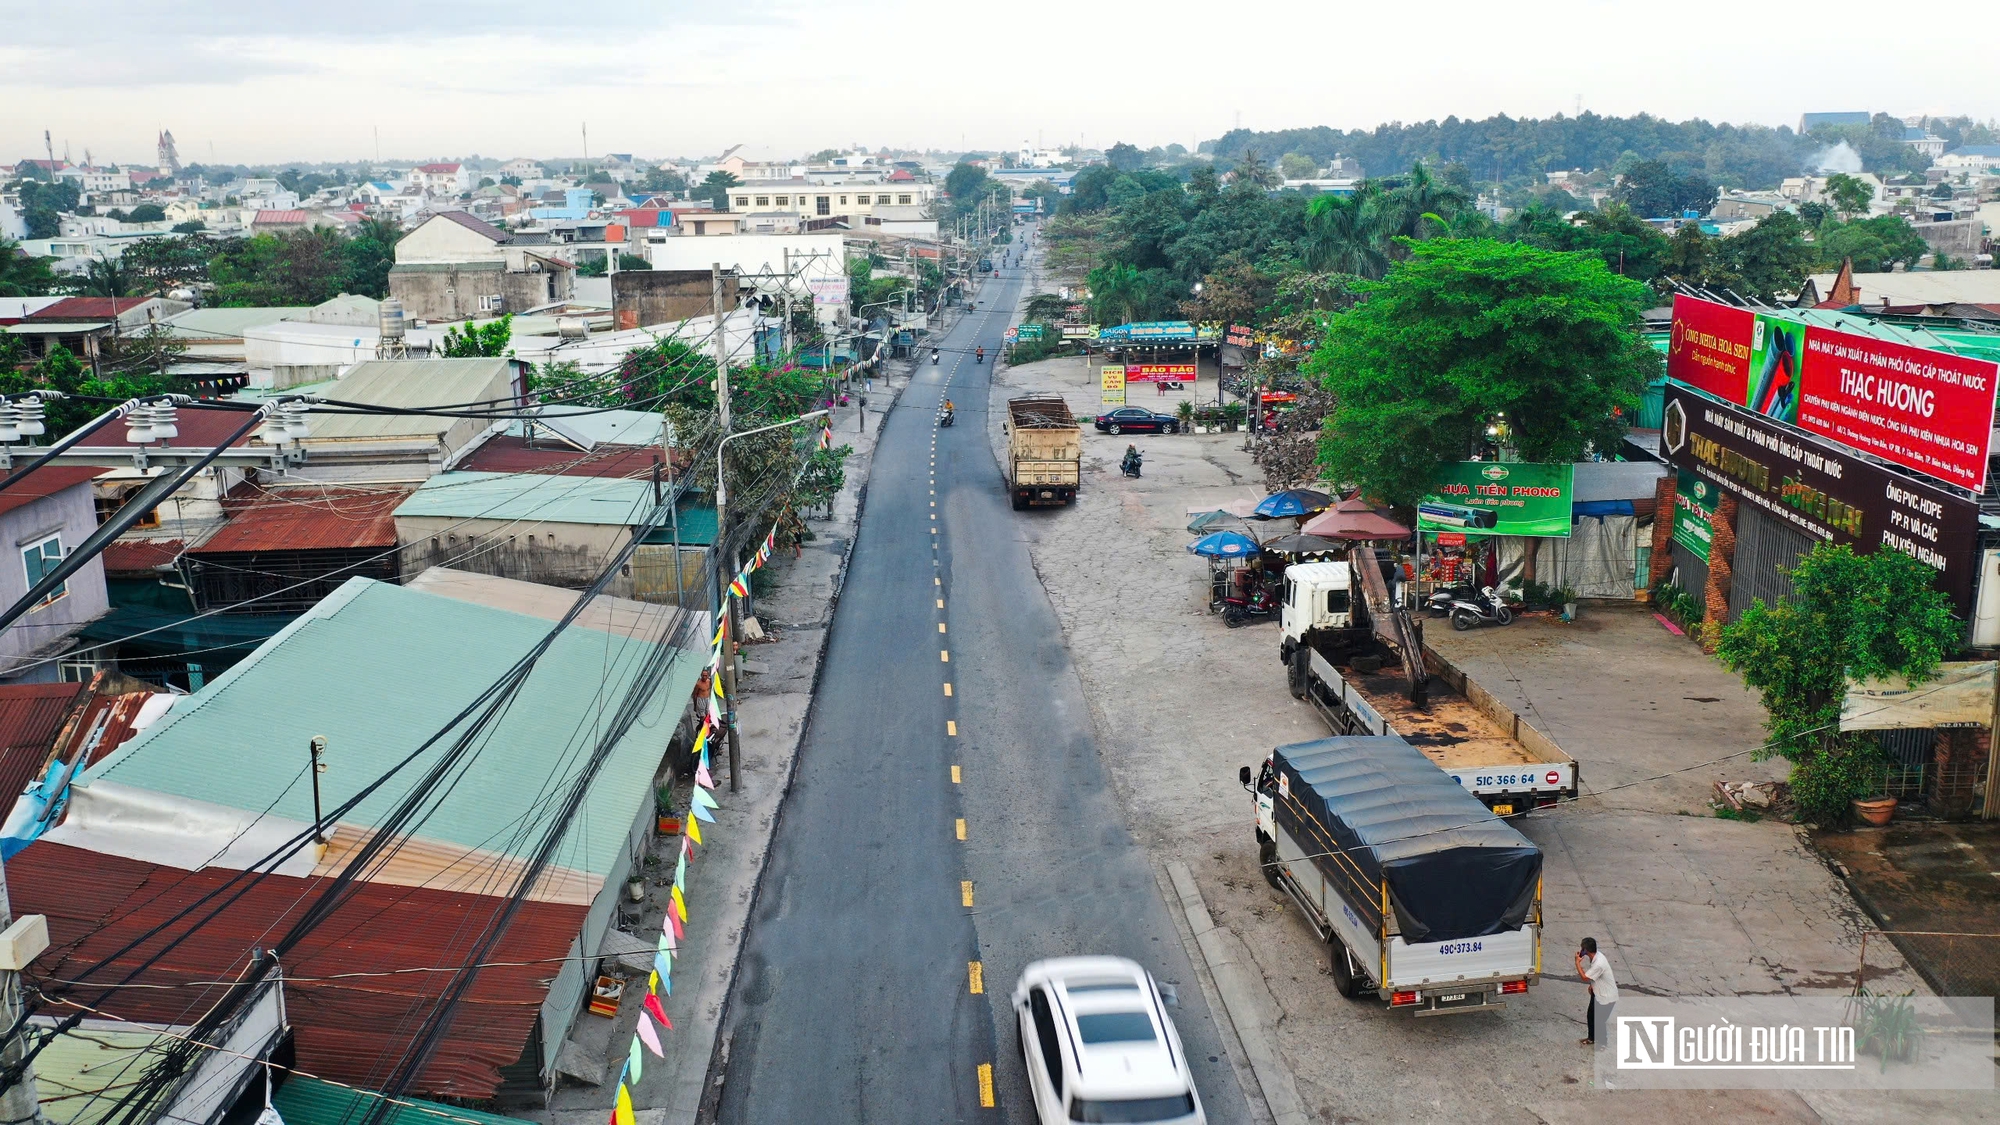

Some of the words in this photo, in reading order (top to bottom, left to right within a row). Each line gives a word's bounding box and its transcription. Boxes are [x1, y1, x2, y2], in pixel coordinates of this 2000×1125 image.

[1686, 323, 1698, 344] ỐNG
[1718, 338, 1732, 355] HOA
[1734, 344, 1750, 360] SEN
[1808, 338, 1820, 352] NHÀ
[1821, 341, 1834, 354] MÁY
[1864, 352, 1868, 363] &
[1869, 353, 1887, 368] PHÂN
[1888, 356, 1904, 372] PHỐI
[1905, 358, 1921, 376] ỐNG
[1922, 362, 1936, 379] CẤP
[1938, 369, 1962, 385] THOÁT
[1962, 374, 1986, 391] NƯỚC
[1840, 368, 1875, 404] THẠC
[1876, 378, 1935, 418] HƯƠNG
[1746, 428, 1751, 440] &
[1780, 435, 1791, 458] ỐNG
[1791, 442, 1803, 462] CẤP
[1804, 452, 1824, 471] THOÁT
[1824, 458, 1842, 479] NƯỚC
[1900, 422, 1907, 434] VÀ
[1951, 439, 1964, 452] HOA
[1966, 444, 1978, 456] SEN
[1440, 482, 1470, 497] HỰA
[1512, 486, 1560, 497] PHONG
[1886, 480, 1902, 503] ỐNG
[1920, 498, 1942, 520] HDPE
[1891, 510, 1909, 530] PP.R
[1911, 518, 1920, 535] VÀ
[1921, 523, 1938, 542] CÁC
[1883, 530, 1898, 551] PHỤ
[1917, 546, 1946, 572] NGÀNH
